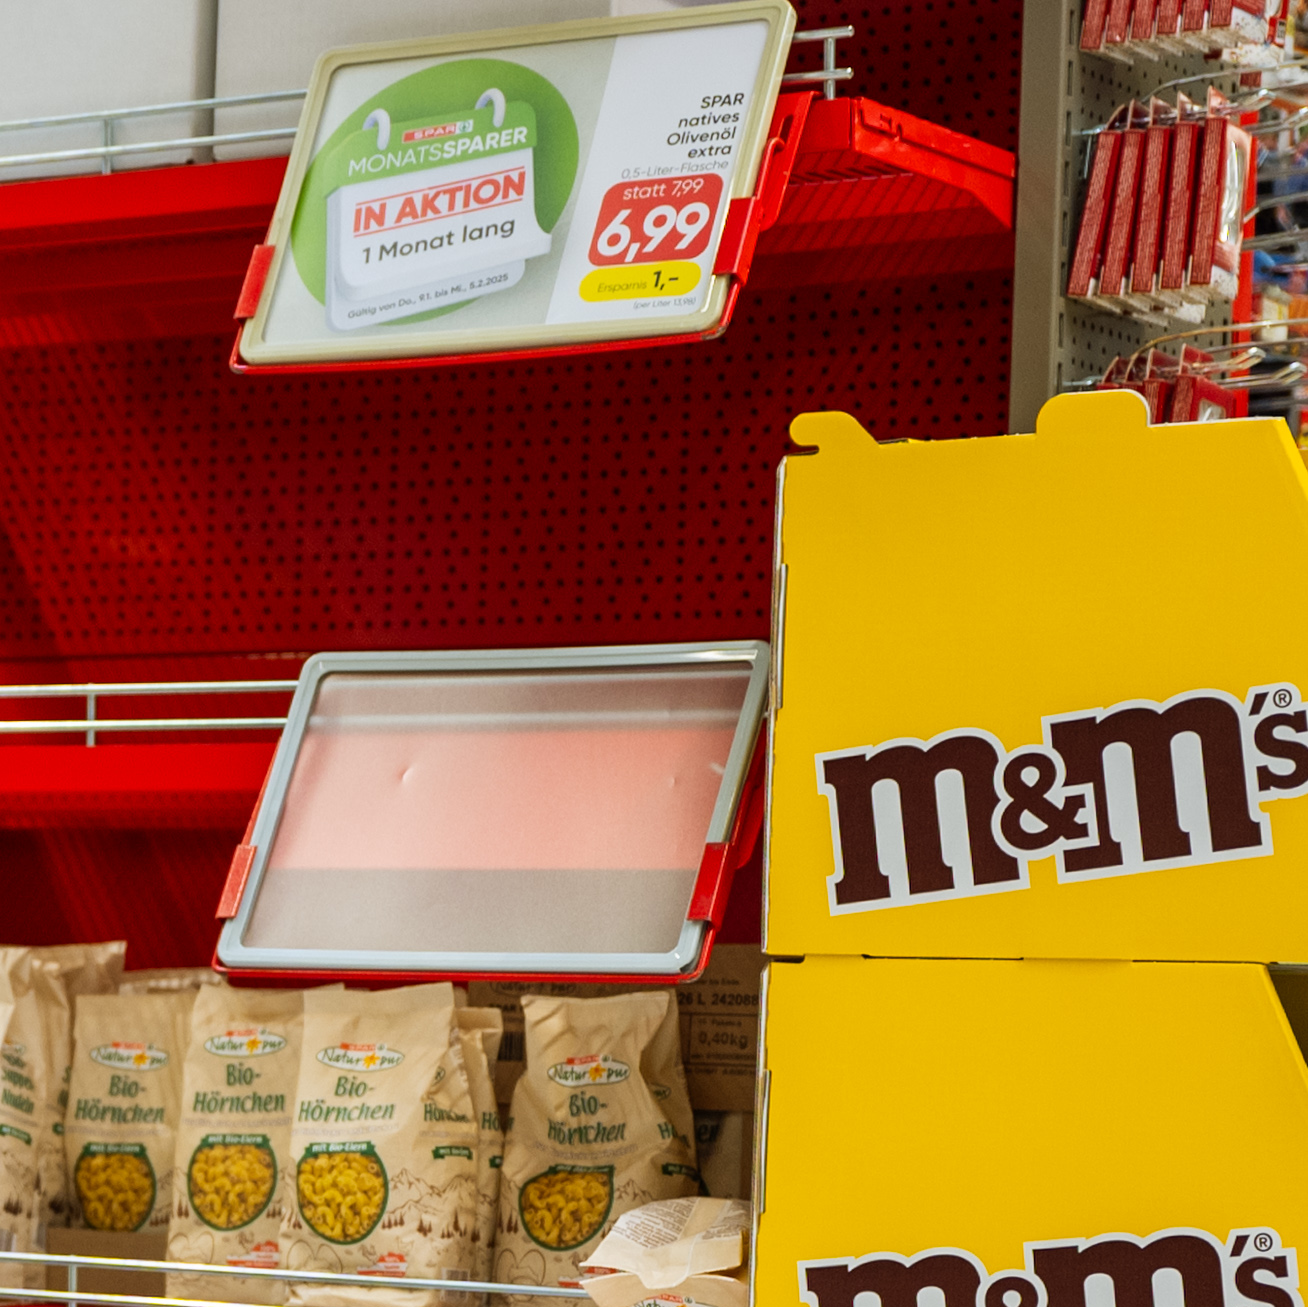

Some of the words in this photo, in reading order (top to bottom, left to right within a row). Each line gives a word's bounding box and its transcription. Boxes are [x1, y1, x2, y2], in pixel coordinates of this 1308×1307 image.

[700, 92, 745, 109] SPAR
[678, 111, 740, 128] natives
[667, 126, 736, 146] Olivenöl
[348, 126, 528, 177] MONATSSPARER
[687, 144, 732, 159] extra
[621, 159, 729, 180] 0,5-Liter-Flasche
[623, 183, 667, 200] statt
[671, 178, 705, 198] 7,99
[353, 202, 387, 233] IN
[394, 171, 526, 224] AKTION
[362, 246, 371, 264] 1
[378, 229, 455, 262] Monat
[462, 219, 516, 243] lang
[597, 201, 711, 263] 6,99
[597, 279, 647, 295] Ersparnis
[347, 306, 377, 319] Gültig
[379, 302, 396, 312] von
[434, 287, 448, 298] bis
[321, 1047, 362, 1066] Natur
[226, 1062, 262, 1087] Bio-
[554, 1064, 589, 1082] Natur
[109, 1074, 146, 1098] Bio-
[334, 1074, 375, 1098] Bio-
[75, 1097, 165, 1124] Hörnchen
[192, 1090, 286, 1114] Hörnchen
[298, 1099, 396, 1123] Hörnchen
[569, 1090, 608, 1118] Bio-
[547, 1119, 626, 1145] Hörnchen
